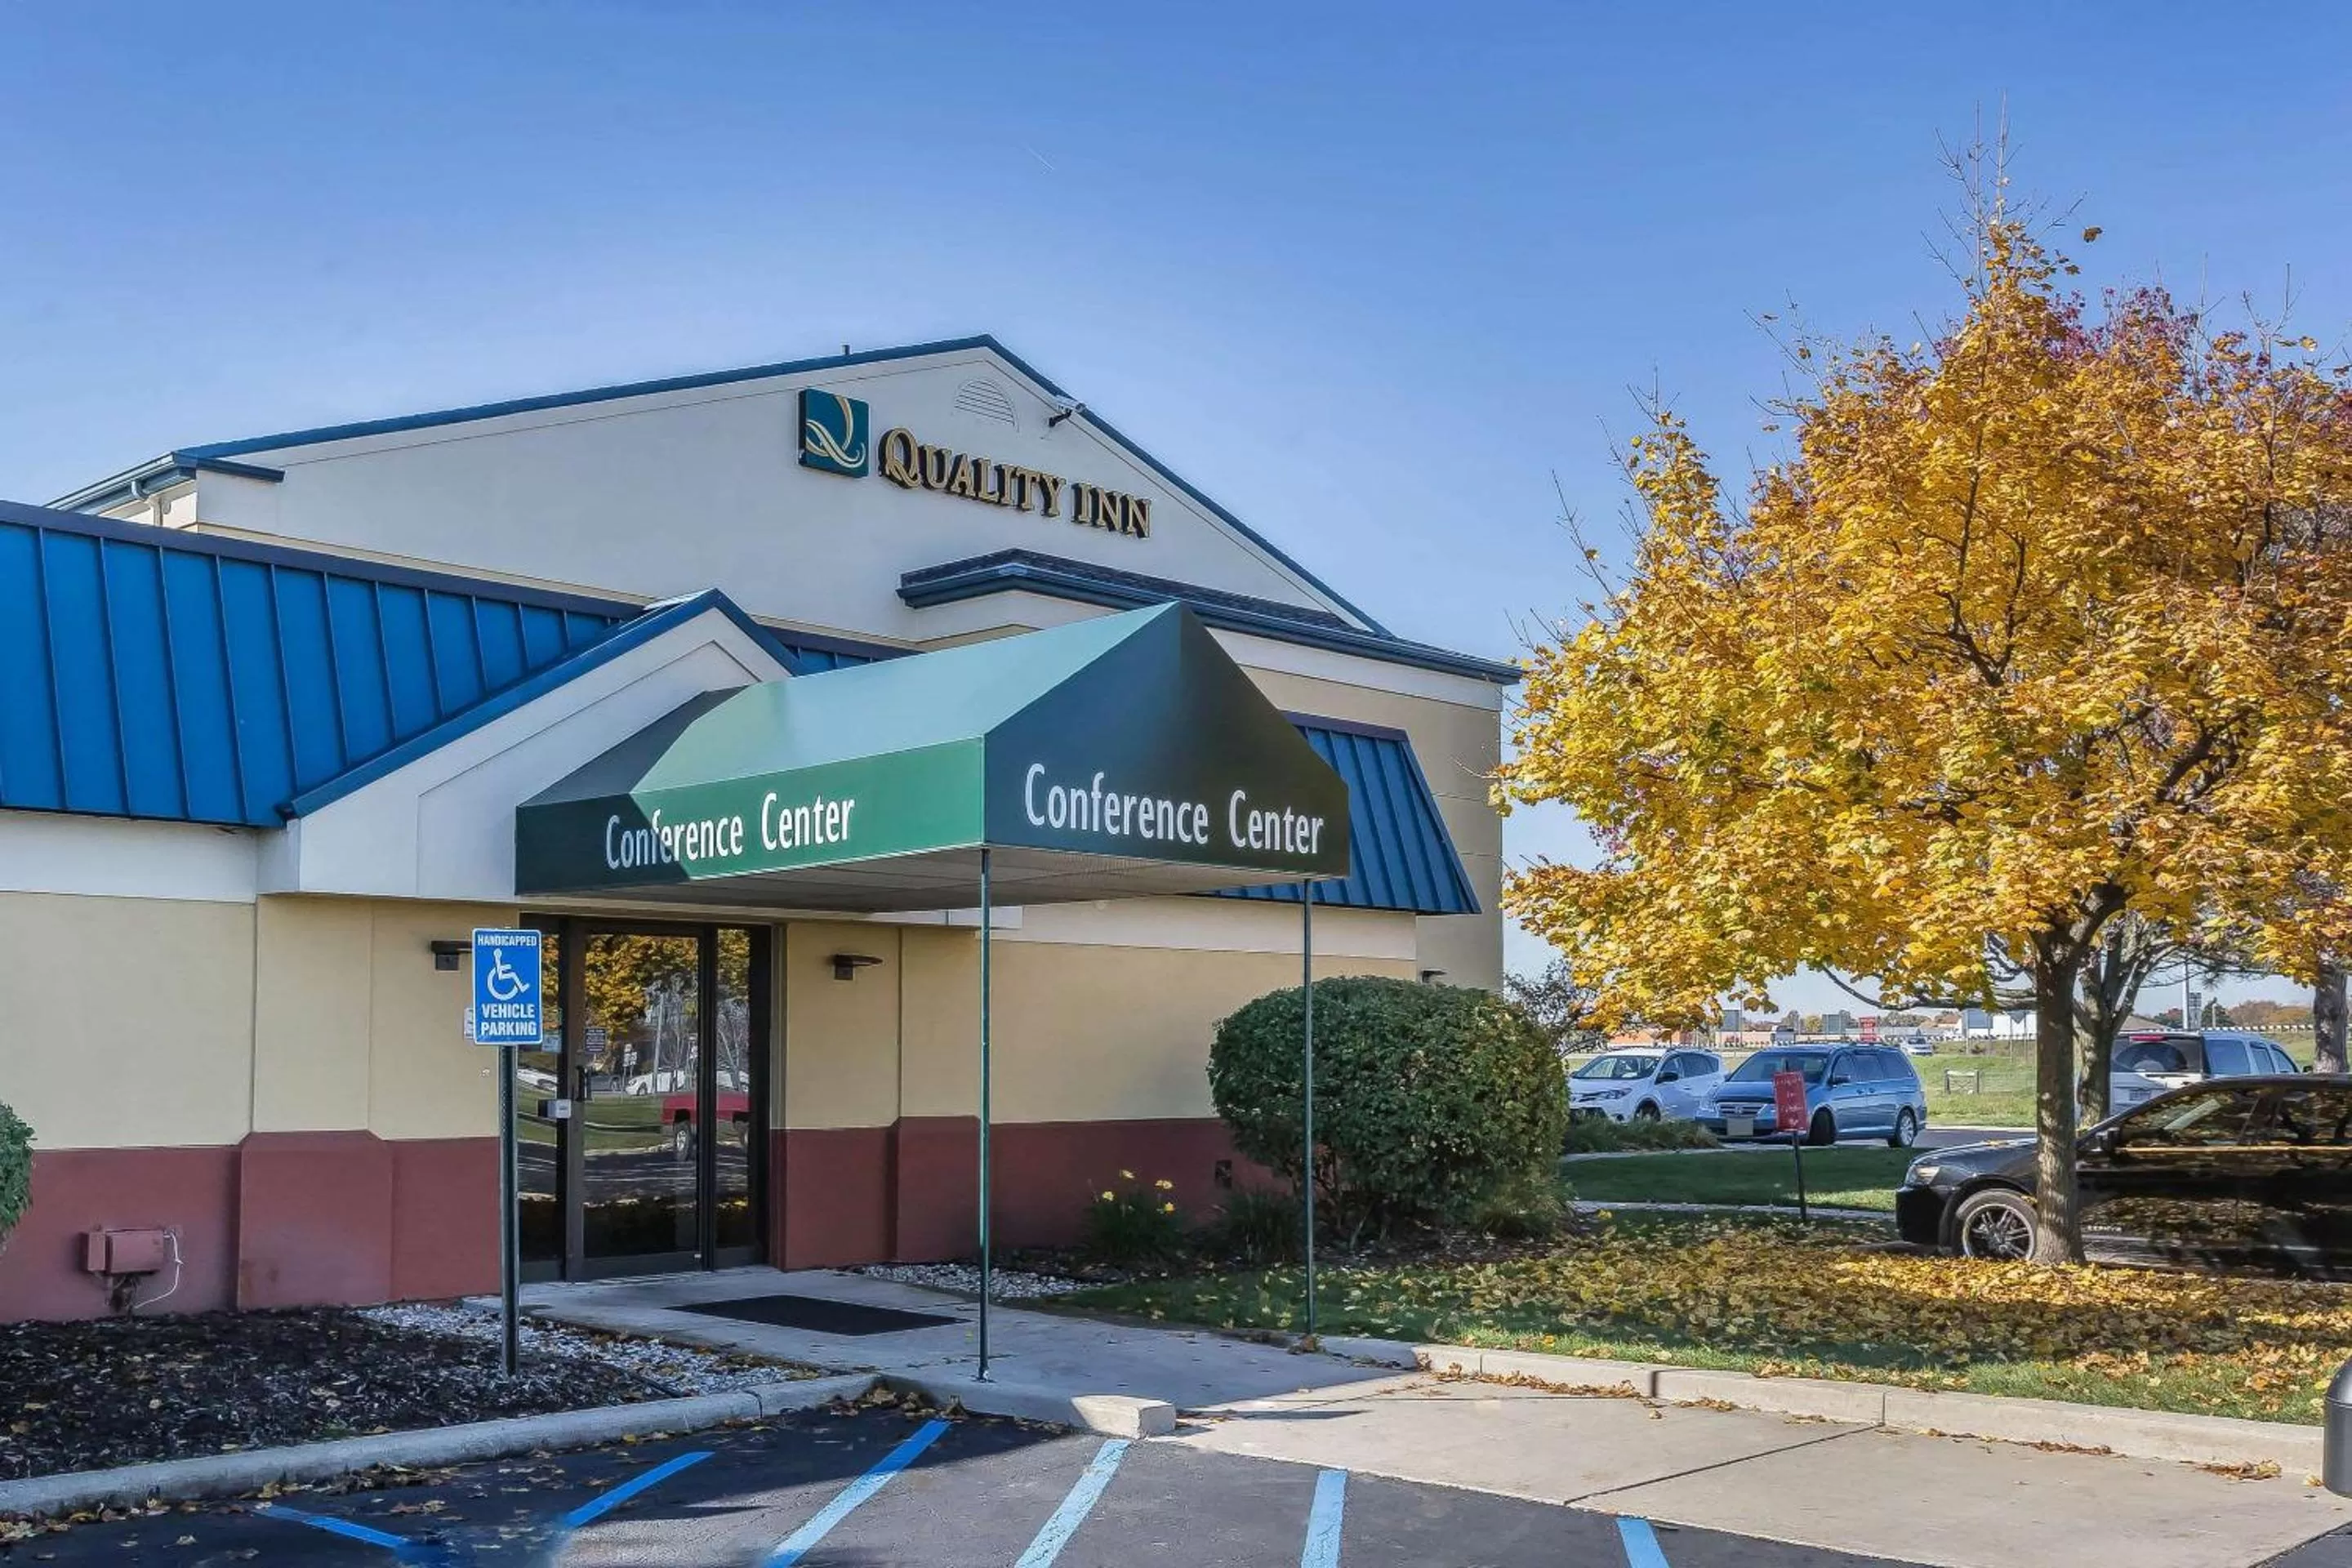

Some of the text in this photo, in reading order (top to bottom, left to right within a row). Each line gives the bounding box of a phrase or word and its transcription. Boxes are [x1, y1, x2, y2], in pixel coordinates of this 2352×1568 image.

[878, 427, 1153, 539] QUALITY INN
[605, 792, 855, 870] Conference Center
[1024, 763, 1324, 854] Conference Center
[477, 934, 537, 946] HANDICAPPED
[481, 1022, 537, 1036] PARKING
[482, 1003, 536, 1018] VEHICLE
